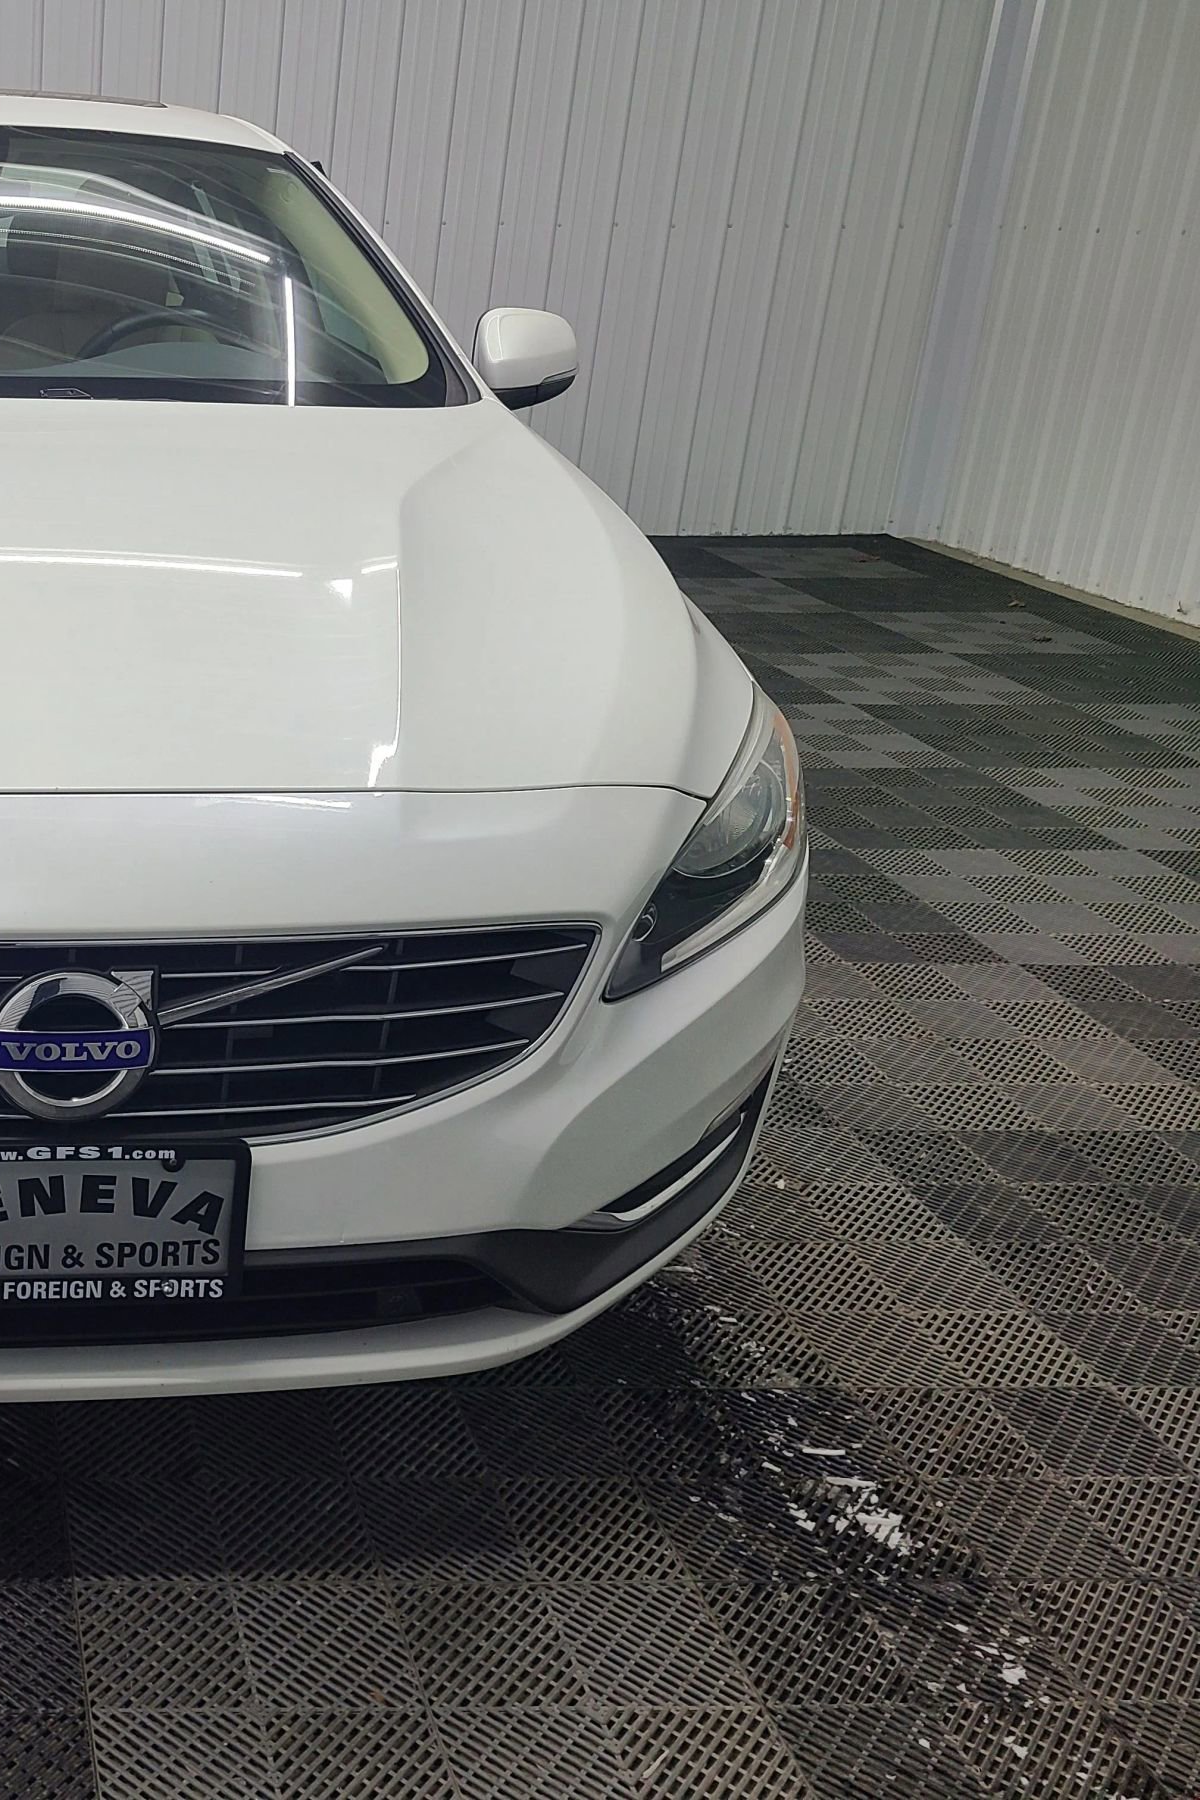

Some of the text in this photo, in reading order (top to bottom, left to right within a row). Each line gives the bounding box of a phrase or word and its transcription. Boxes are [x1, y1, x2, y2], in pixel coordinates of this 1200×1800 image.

[1, 1040, 141, 1061] VOLVO
[61, 1244, 84, 1269] &
[95, 1239, 221, 1269] SPORTS
[3, 1280, 102, 1299] FOREIGN
[110, 1281, 126, 1298] &
